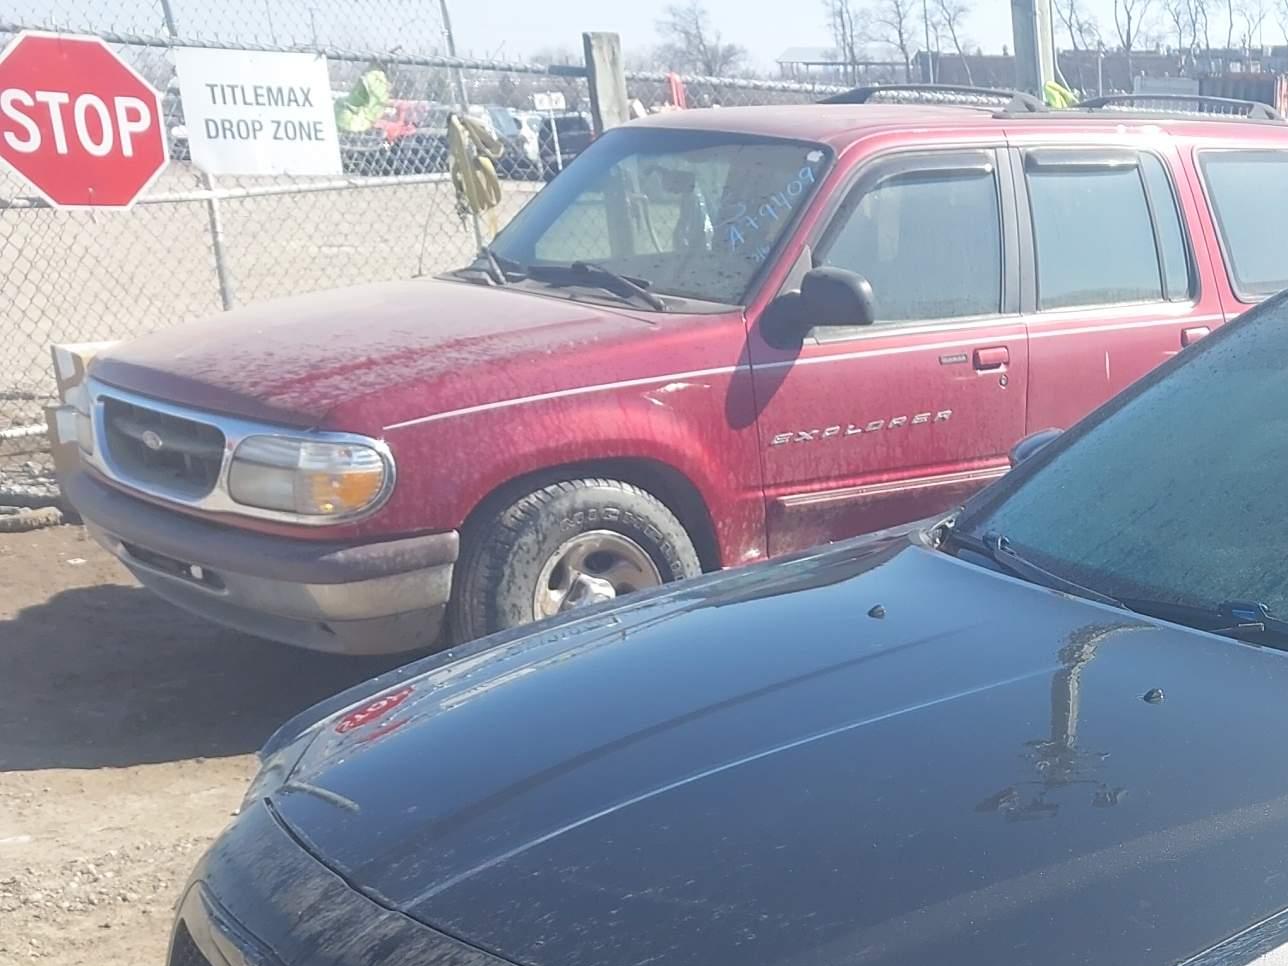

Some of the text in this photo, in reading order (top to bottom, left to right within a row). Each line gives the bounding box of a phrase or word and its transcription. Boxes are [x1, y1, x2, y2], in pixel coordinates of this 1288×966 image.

[205, 83, 314, 108] TITLEMAX
[0, 87, 152, 158] STOP
[204, 117, 326, 142] DROP ZONE
[770, 408, 953, 447] EXPLORER
